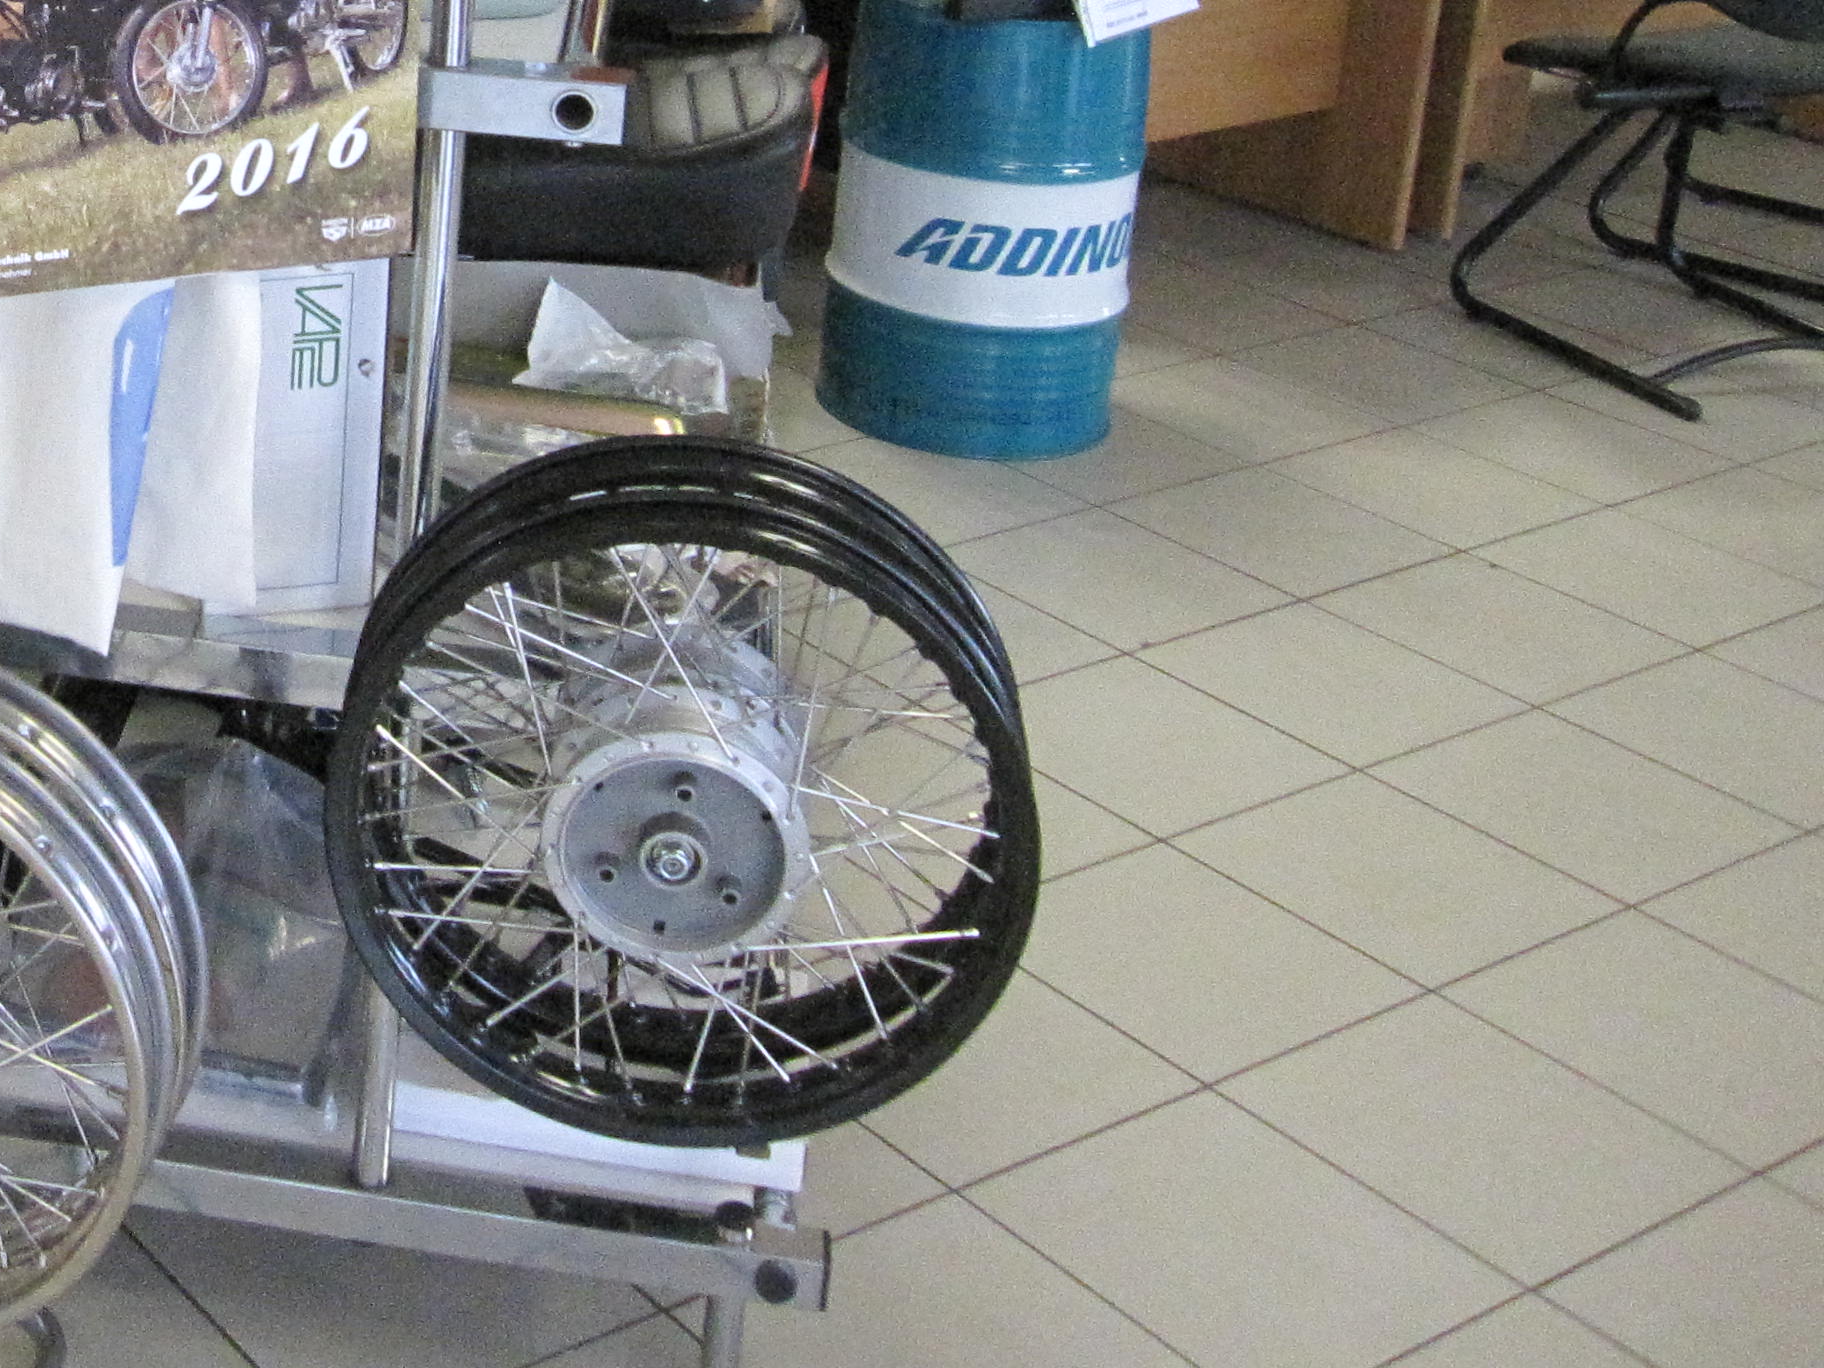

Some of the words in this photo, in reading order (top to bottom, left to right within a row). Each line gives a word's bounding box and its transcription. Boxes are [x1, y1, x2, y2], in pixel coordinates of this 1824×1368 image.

[176, 105, 372, 217] 2016
[34, 248, 70, 262] GmbH
[895, 212, 1134, 278] ADDINO
